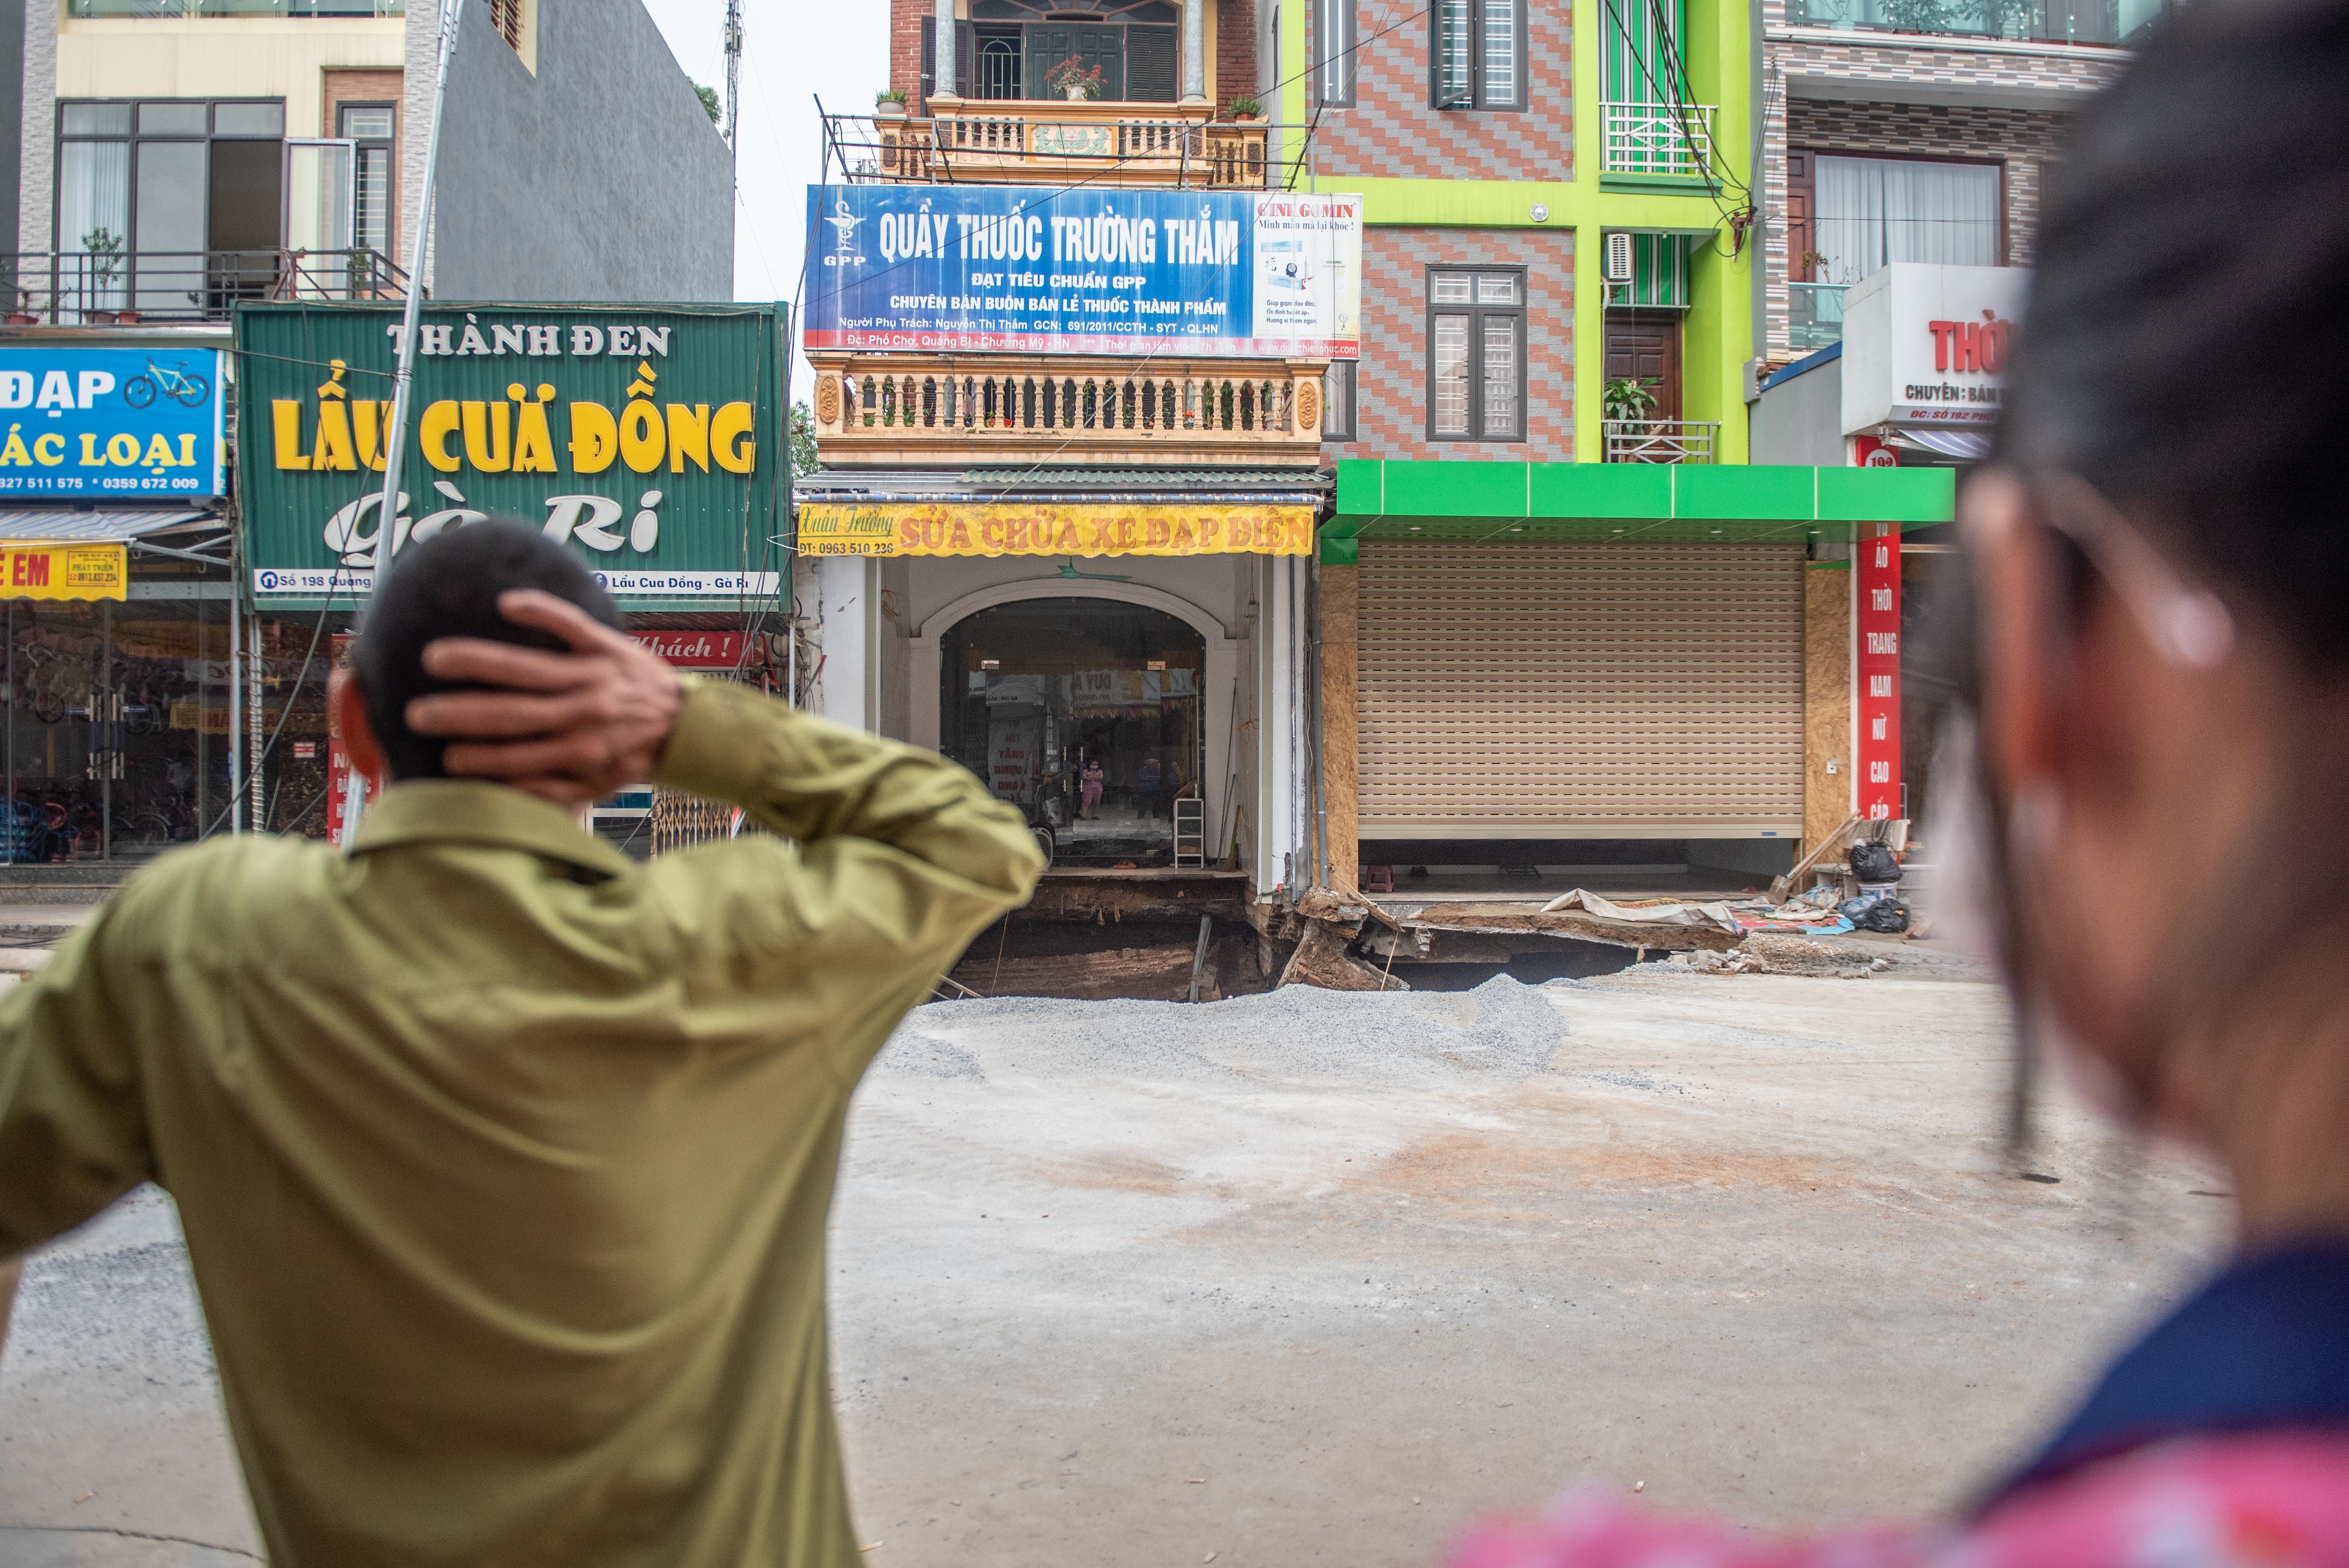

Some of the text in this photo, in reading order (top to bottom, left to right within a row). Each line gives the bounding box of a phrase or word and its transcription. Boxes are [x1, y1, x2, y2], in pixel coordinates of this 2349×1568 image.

[880, 198, 1238, 265] QUẦY THUỐC TRƯỜNG THẮM
[1259, 219, 1280, 229] Minh
[824, 256, 866, 266] GPP
[971, 271, 1147, 289] ĐẠT TIÊU CHUẨN GPP
[890, 294, 1226, 315] CHUYÊN BÁN BUÔN BÁN LẺ THUỐC THÀNH PHẨM
[387, 313, 672, 357] THÀNH ĐEN
[840, 317, 872, 329] Người
[876, 317, 896, 329] Phụ
[899, 318, 932, 328] Trách:
[935, 317, 976, 331] Nguyễn
[979, 319, 995, 331] Thị
[998, 318, 1028, 330] Thắm
[1034, 320, 1061, 330] GCN:
[1068, 321, 1146, 332] 691/2011/CCTH
[1156, 323, 1178, 333] SYT
[1187, 324, 1219, 335] QLHN
[847, 334, 865, 345] Đc:
[868, 333, 890, 345] Phố
[892, 335, 918, 347] Chợ,
[921, 335, 957, 348] Quảng
[960, 336, 971, 349] Bị
[981, 336, 1026, 349] Chương
[1028, 337, 1045, 350] Mỹ
[1054, 338, 1070, 348] HN
[1104, 339, 1127, 350] Thời
[1130, 340, 1151, 352] gian
[1259, 343, 1357, 354] www.ducthienphuc.com
[1929, 309, 2014, 374] THỜ
[0, 370, 116, 418] ĐẠP
[272, 359, 395, 472] LẨU
[568, 360, 756, 473] ĐỒNG
[1932, 408, 1949, 419] SỐ
[78, 433, 198, 475] LOẠI
[27, 478, 52, 489] 511
[57, 478, 83, 489] 575
[102, 478, 137, 489] 0359
[142, 478, 168, 489] 672
[172, 478, 199, 489] 009
[541, 490, 662, 553] Ri
[799, 506, 839, 533] Xuân
[900, 504, 1311, 554] SỬA CHỮA XE ĐẠP ĐIỆN
[799, 542, 894, 554] ĐT: 0963 510 236
[1875, 541, 1888, 568] ÁO
[12, 554, 50, 586] EM
[301, 576, 324, 586] 198
[612, 574, 635, 588] Lẩu
[640, 578, 664, 588] Cua
[668, 576, 702, 590] Đồng
[715, 577, 732, 588] Gà
[1872, 583, 1892, 611] THỜI
[1867, 633, 1897, 654] TRANG
[1870, 676, 1892, 697] NAM
[1873, 713, 1887, 740] NỮ
[1871, 761, 1889, 783] CAO
[1870, 796, 1889, 820] CẤP
